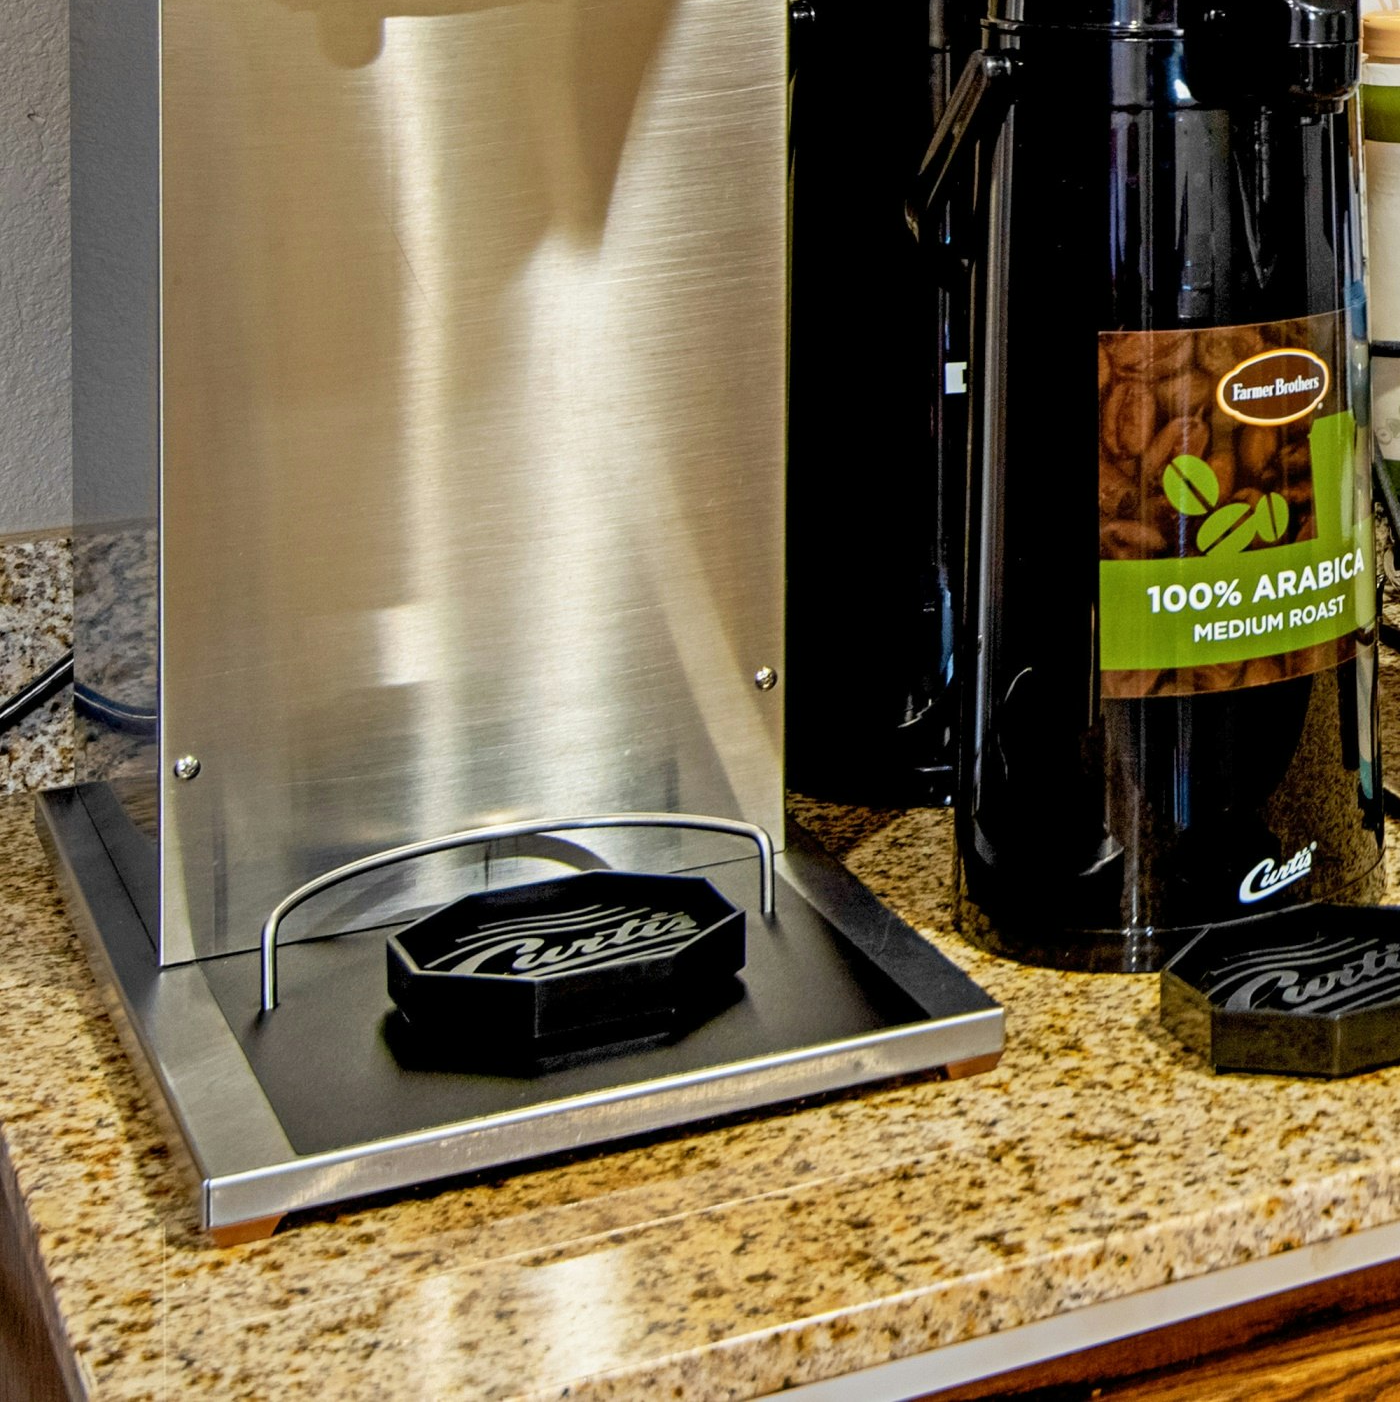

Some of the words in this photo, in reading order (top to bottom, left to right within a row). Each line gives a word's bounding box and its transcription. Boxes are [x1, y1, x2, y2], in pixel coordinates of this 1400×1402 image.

[1232, 381, 1275, 401] Farmer
[1275, 375, 1320, 396] Brothers
[1147, 578, 1242, 613] 100%
[1252, 548, 1364, 603] ARABICA
[1194, 612, 1284, 643] MEDIUM
[1290, 595, 1345, 629] ROAST
[1238, 846, 1313, 903] Curtis
[450, 911, 699, 974] Curtis
